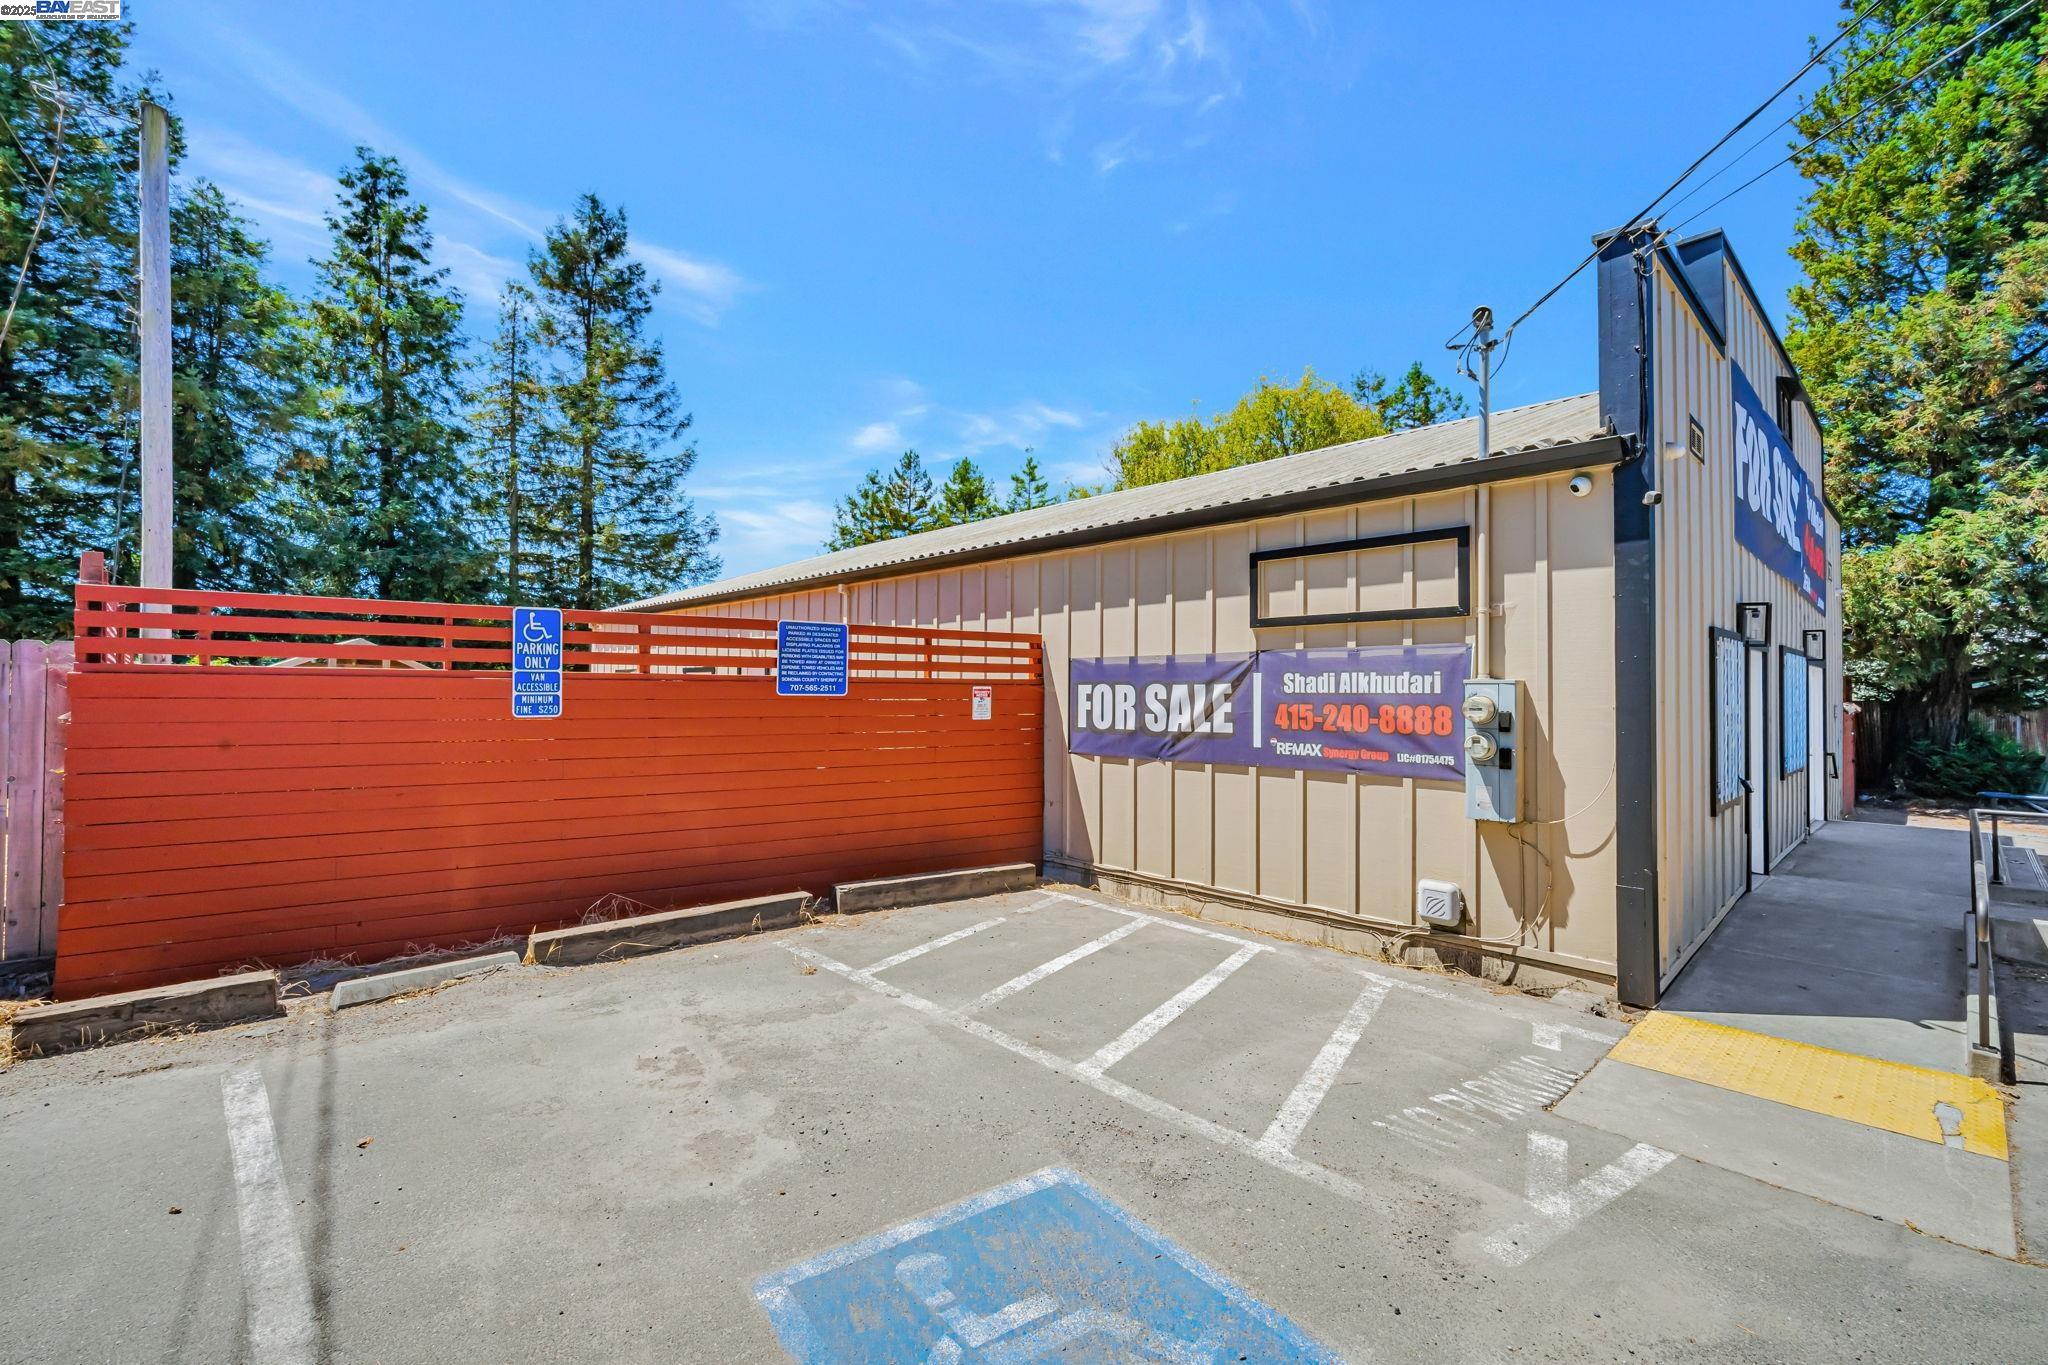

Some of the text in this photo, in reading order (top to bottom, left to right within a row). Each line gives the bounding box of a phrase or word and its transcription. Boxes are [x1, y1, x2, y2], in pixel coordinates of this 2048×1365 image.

[1734, 400, 1772, 523] FOR
[516, 642, 559, 655] PARKING
[524, 656, 551, 669] ONLY
[530, 673, 545, 681] VAN
[1283, 671, 1441, 694] Shadi Alkhudari
[516, 683, 558, 692] ACCESSIBLE
[521, 695, 554, 704] MINIMUM
[515, 705, 558, 714] FINE $250
[1077, 683, 1234, 733] FOR SALE
[1274, 703, 1453, 736] 415-240-8888
[1323, 747, 1359, 760] Synergy
[1360, 749, 1390, 762] Group
[1397, 753, 1455, 766] LIC#01754475
